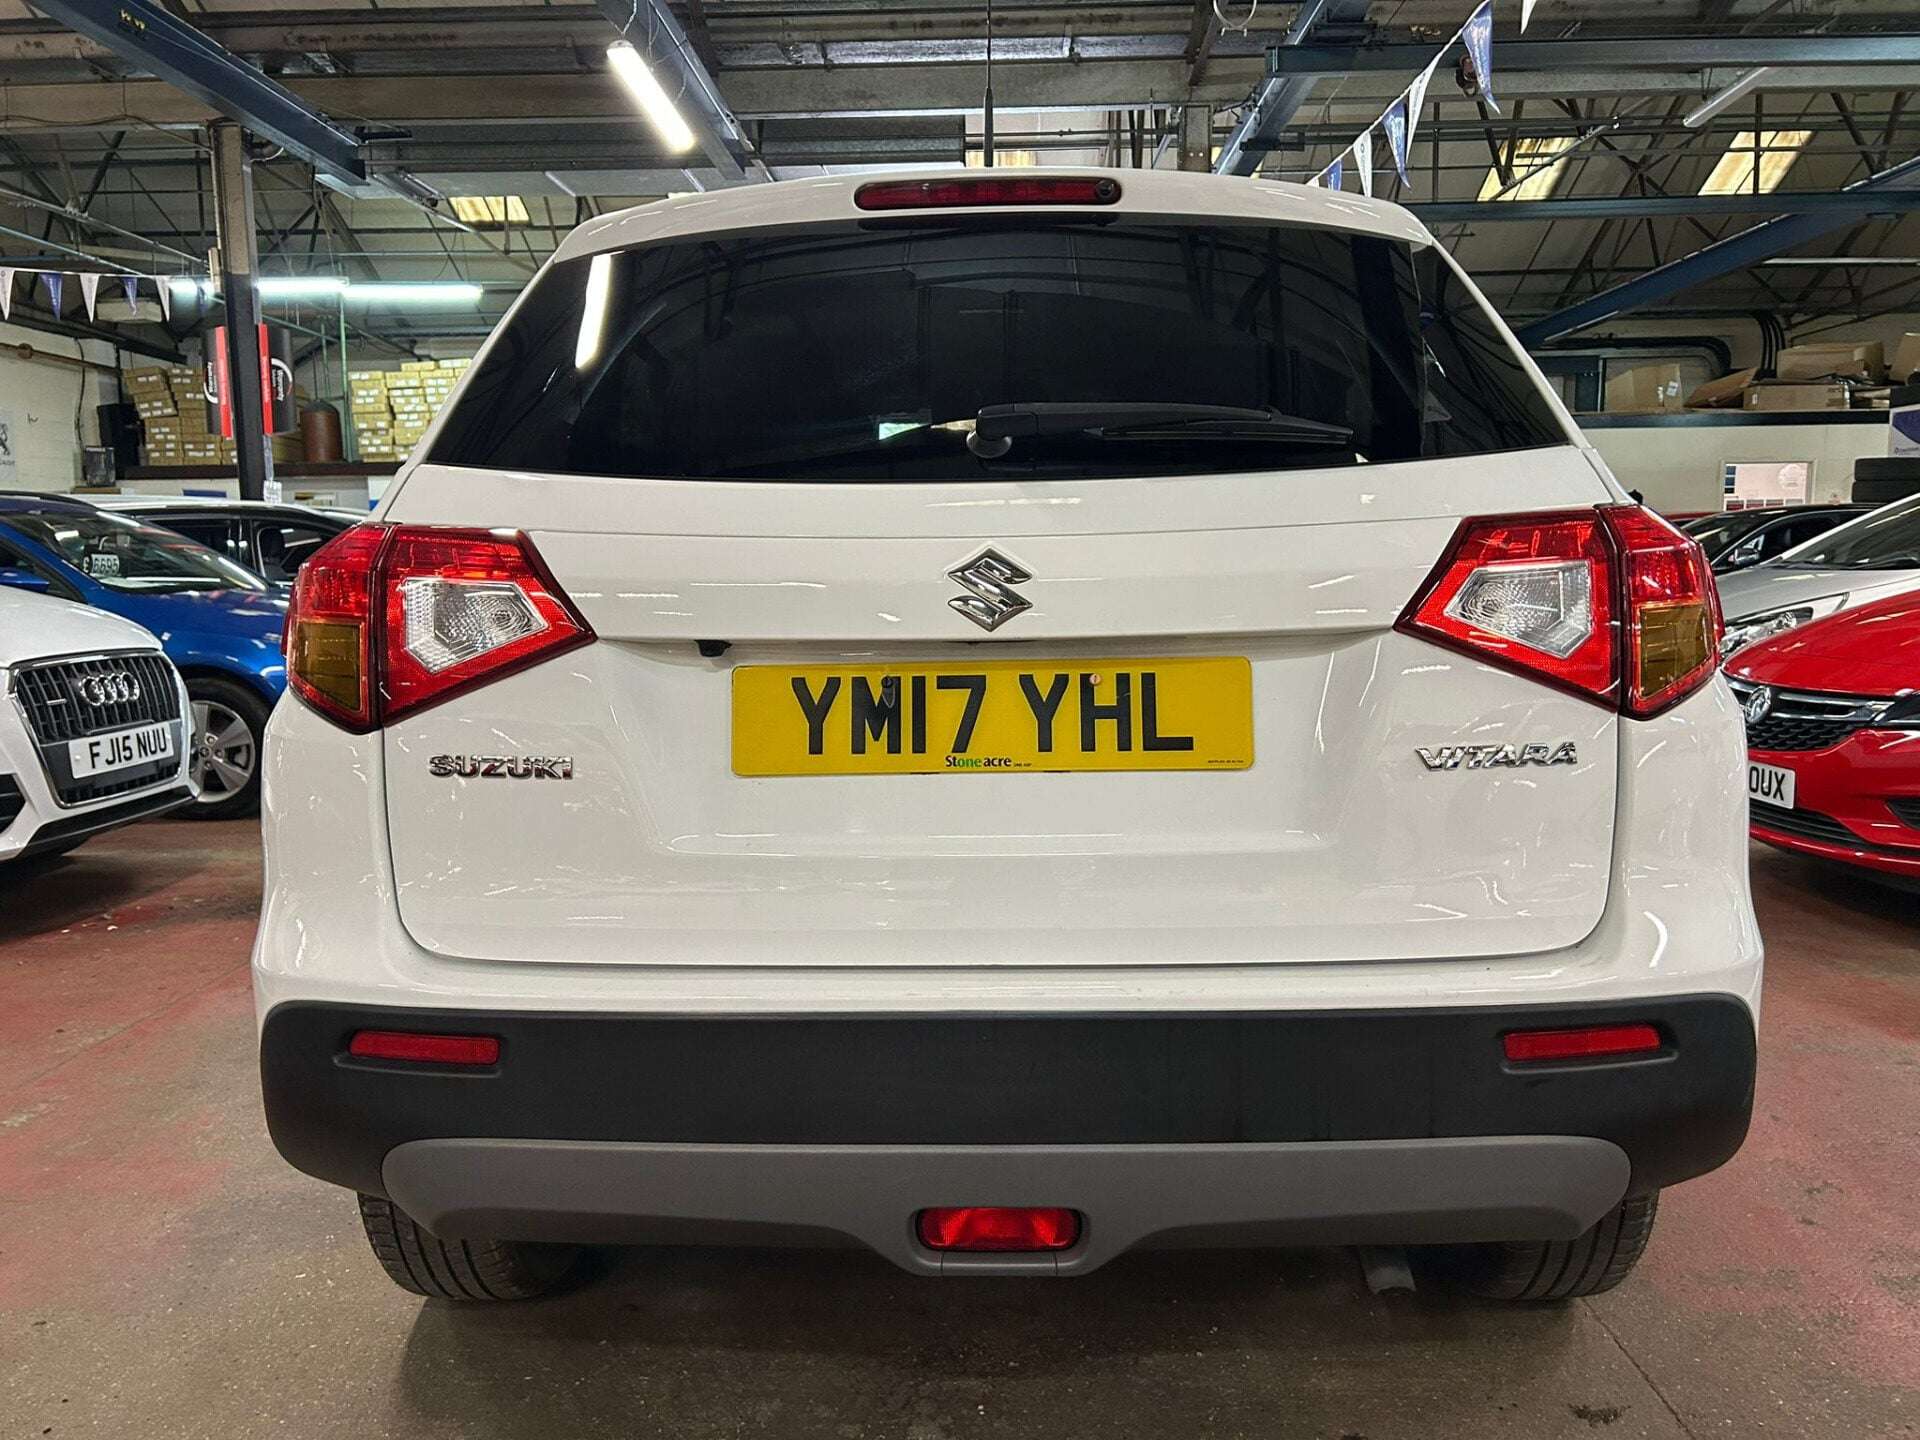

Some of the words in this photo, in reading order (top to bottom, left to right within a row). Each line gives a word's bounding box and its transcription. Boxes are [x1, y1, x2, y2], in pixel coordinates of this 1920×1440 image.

[791, 674, 987, 755] YM17
[1019, 672, 1194, 752] YHL
[88, 735, 133, 769] FJ15
[136, 728, 167, 758] NUU
[1416, 741, 1578, 771] VITARA
[429, 754, 573, 780] SUZUKI
[1749, 766, 1785, 801] OUX
